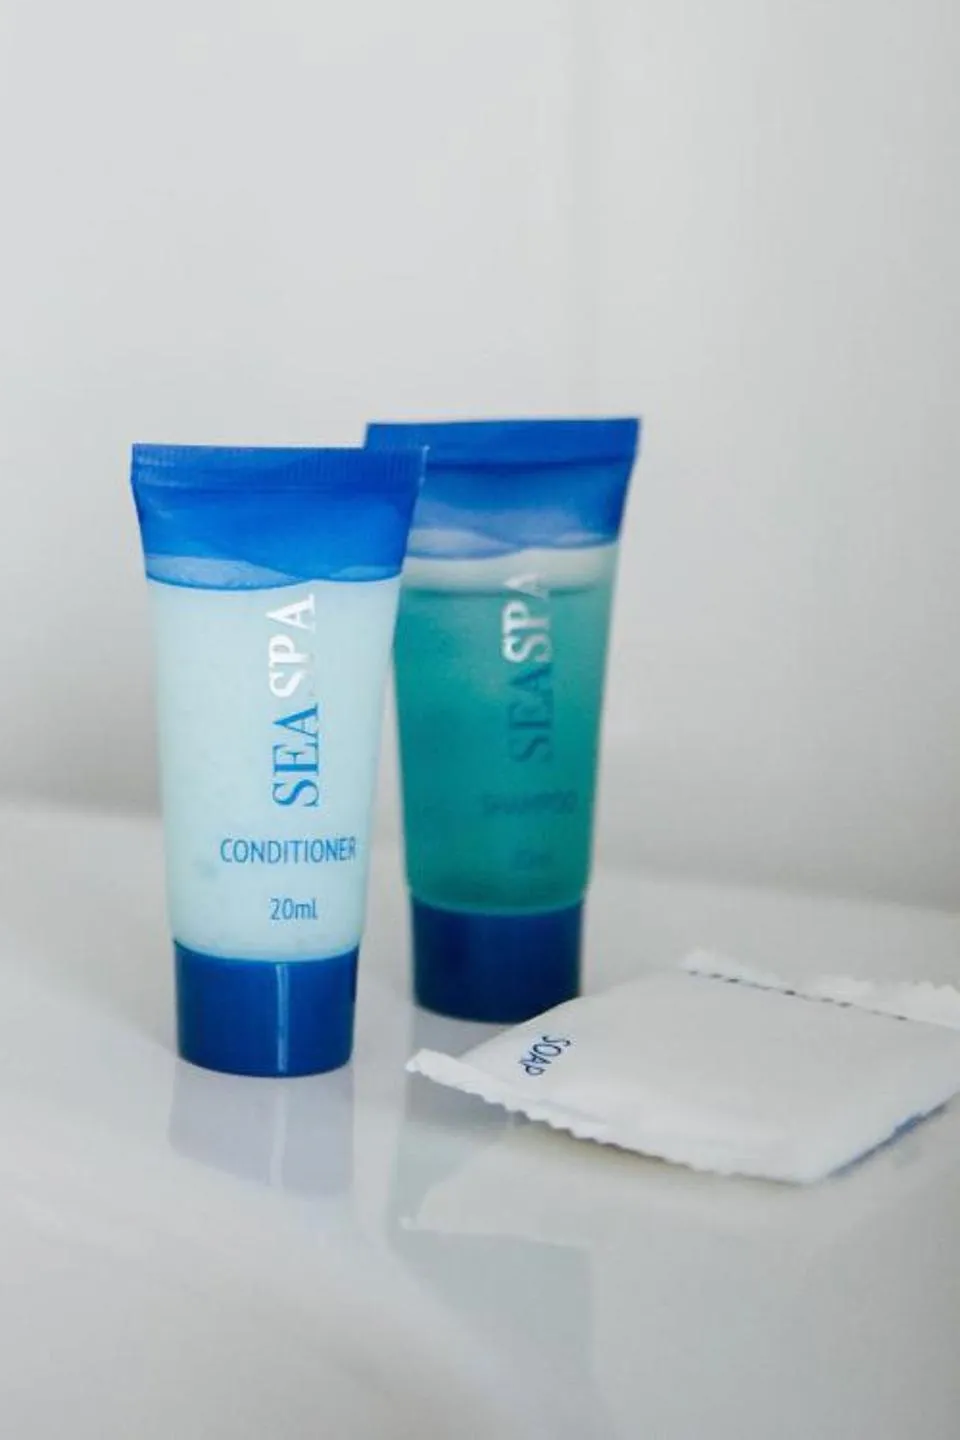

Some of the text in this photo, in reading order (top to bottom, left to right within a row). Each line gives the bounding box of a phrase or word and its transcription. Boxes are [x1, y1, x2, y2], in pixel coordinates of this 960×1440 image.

[220, 836, 356, 864] CONDITIONER
[270, 897, 318, 921] 20ml
[519, 1035, 571, 1076] SOAP
